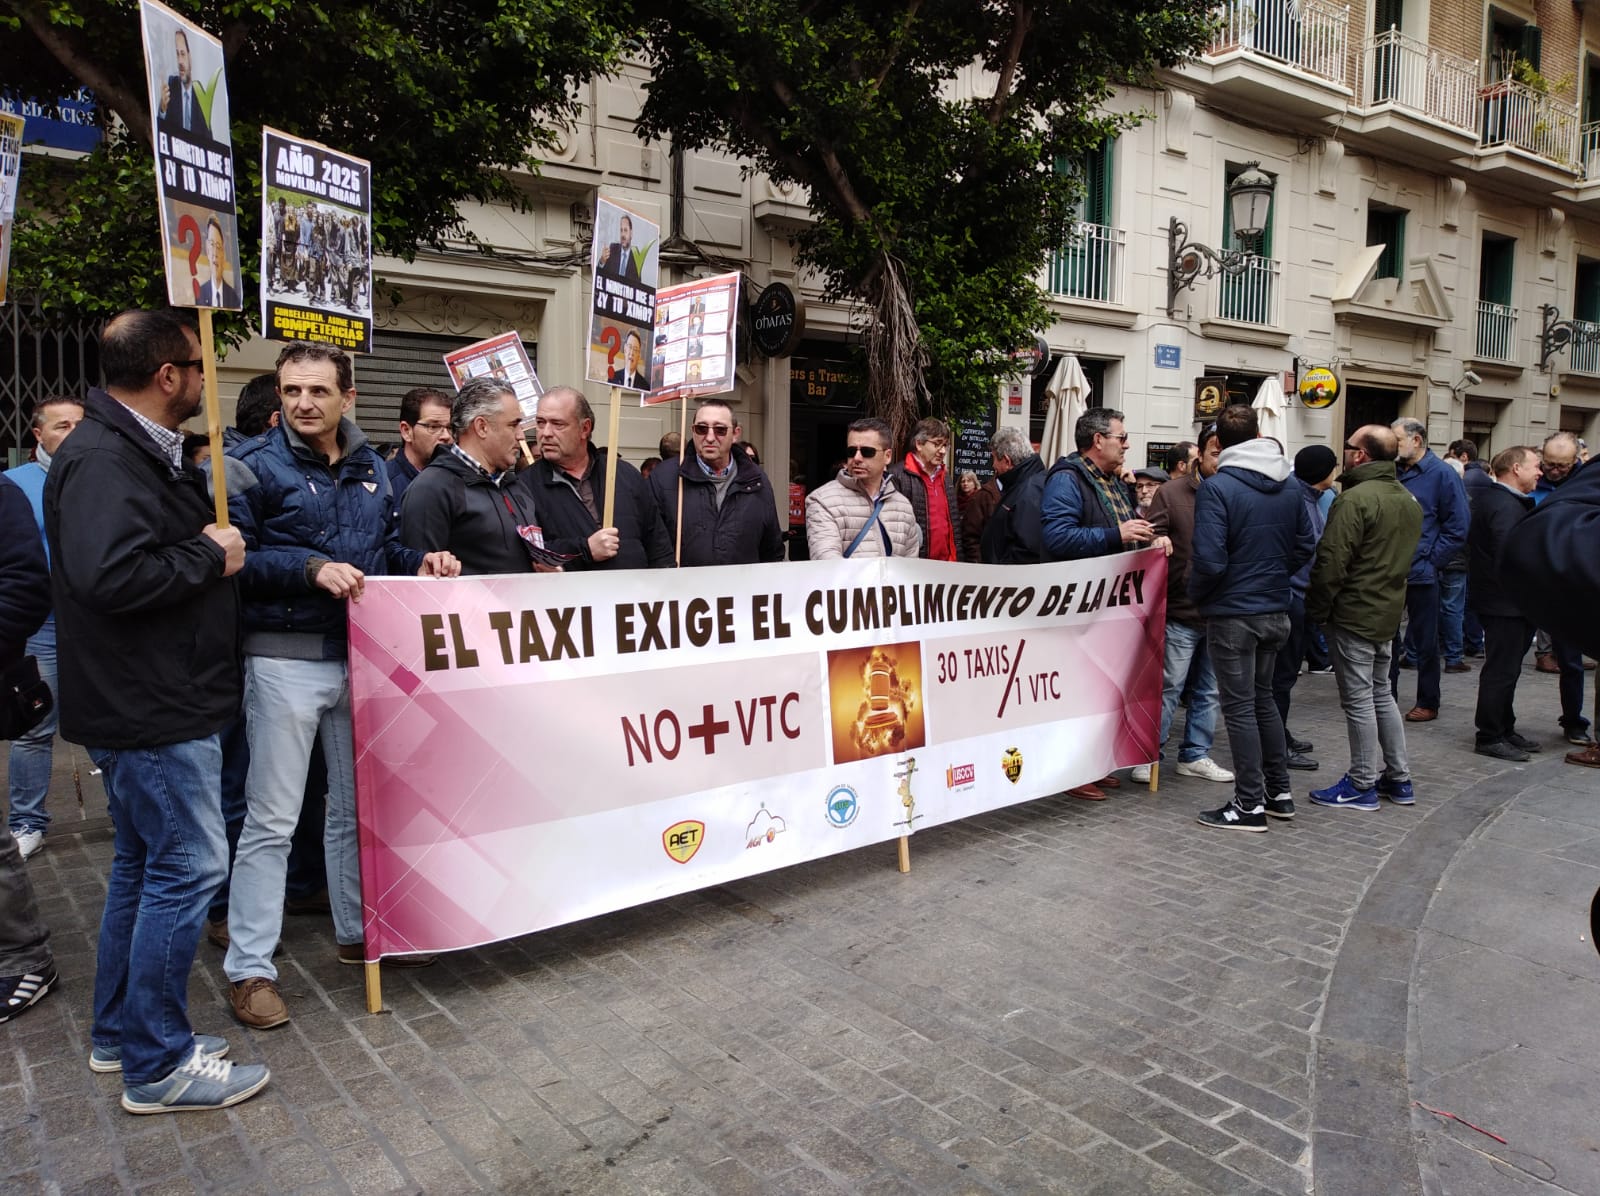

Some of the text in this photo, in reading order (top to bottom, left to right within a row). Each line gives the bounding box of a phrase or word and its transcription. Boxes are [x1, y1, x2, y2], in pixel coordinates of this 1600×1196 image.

[160, 131, 170, 156] EL
[181, 165, 197, 193] TU
[198, 170, 231, 203] XIMO?
[276, 144, 360, 192] AÑO 2025
[275, 170, 362, 207] MOVILIDAD URBANA
[596, 275, 604, 290] EL
[612, 296, 624, 314] TU
[626, 300, 653, 324] XIMO?
[274, 316, 364, 342] COMPETENCIAS
[807, 382, 827, 396] Bar
[420, 569, 1146, 672] EL TAXI EXIGE EL CUMPLIMIENTO DE LA LEY
[937, 651, 958, 684] 30
[964, 644, 1010, 679] TAXIS
[1015, 671, 1061, 705] 1 VTC
[621, 709, 682, 767] NO
[735, 691, 801, 746] VTC
[669, 828, 699, 848] AET
